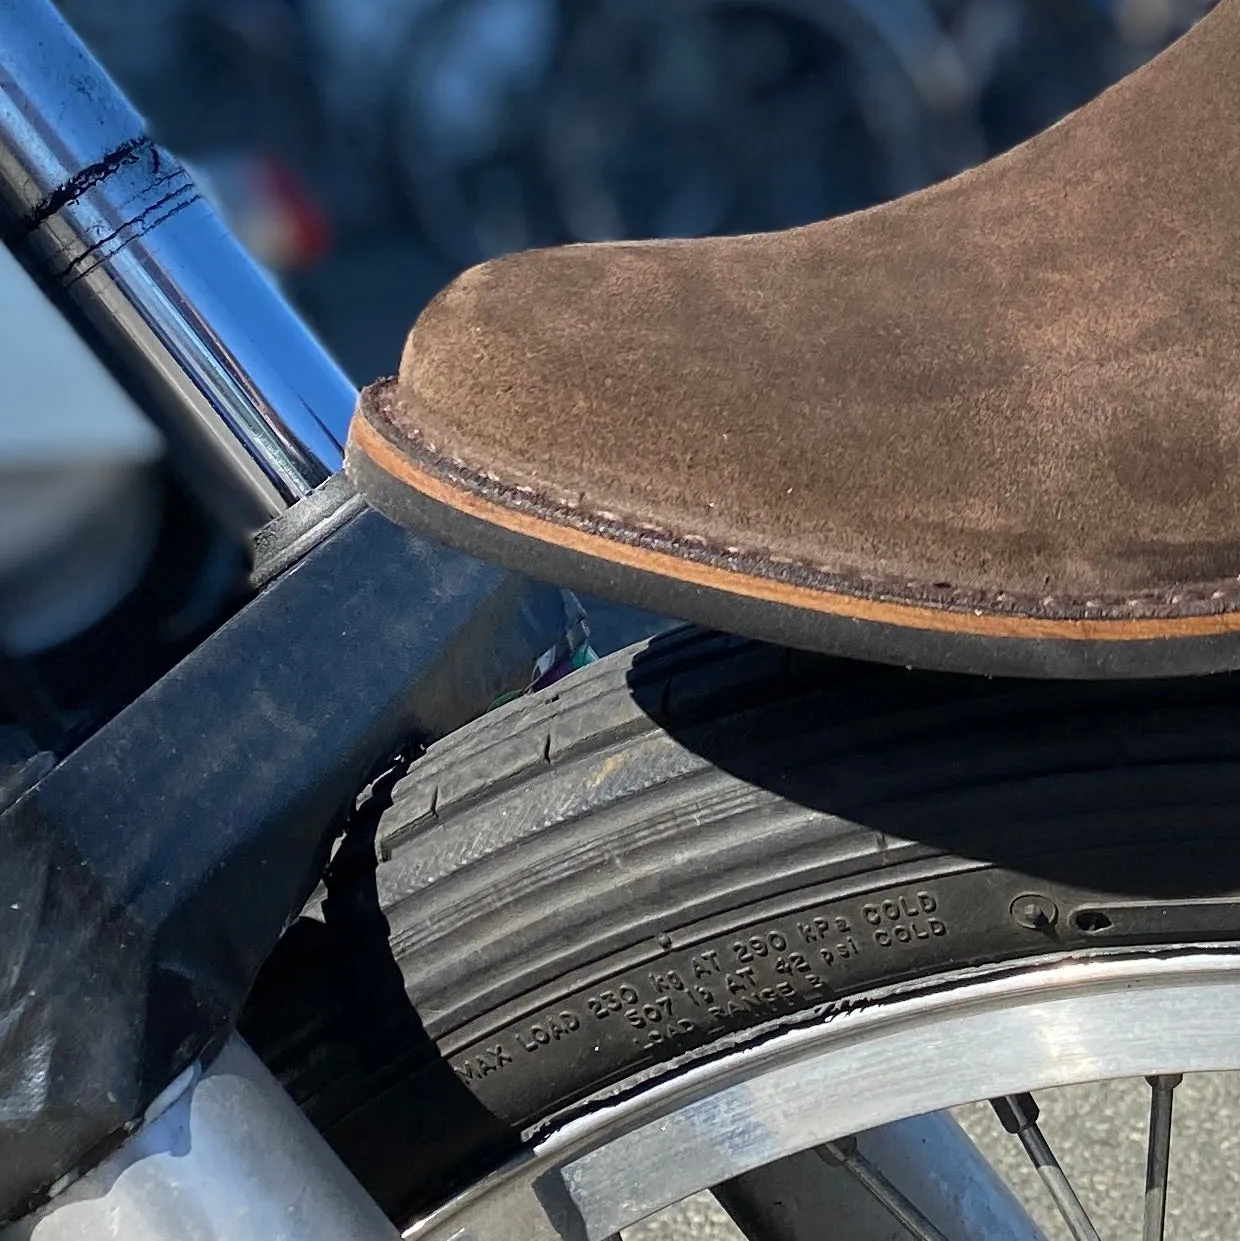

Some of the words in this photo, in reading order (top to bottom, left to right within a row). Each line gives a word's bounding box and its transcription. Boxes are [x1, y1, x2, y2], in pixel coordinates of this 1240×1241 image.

[453, 1043, 513, 1086] MAX
[515, 1010, 581, 1054] LOAD
[587, 983, 639, 1020] 230
[649, 970, 684, 994] kg
[692, 949, 721, 979] AT
[732, 930, 787, 963] 290
[861, 890, 938, 926] COLD
[624, 994, 674, 1030] 507
[725, 966, 757, 995] AT
[775, 951, 812, 977] 42
[872, 917, 948, 948] COLD
